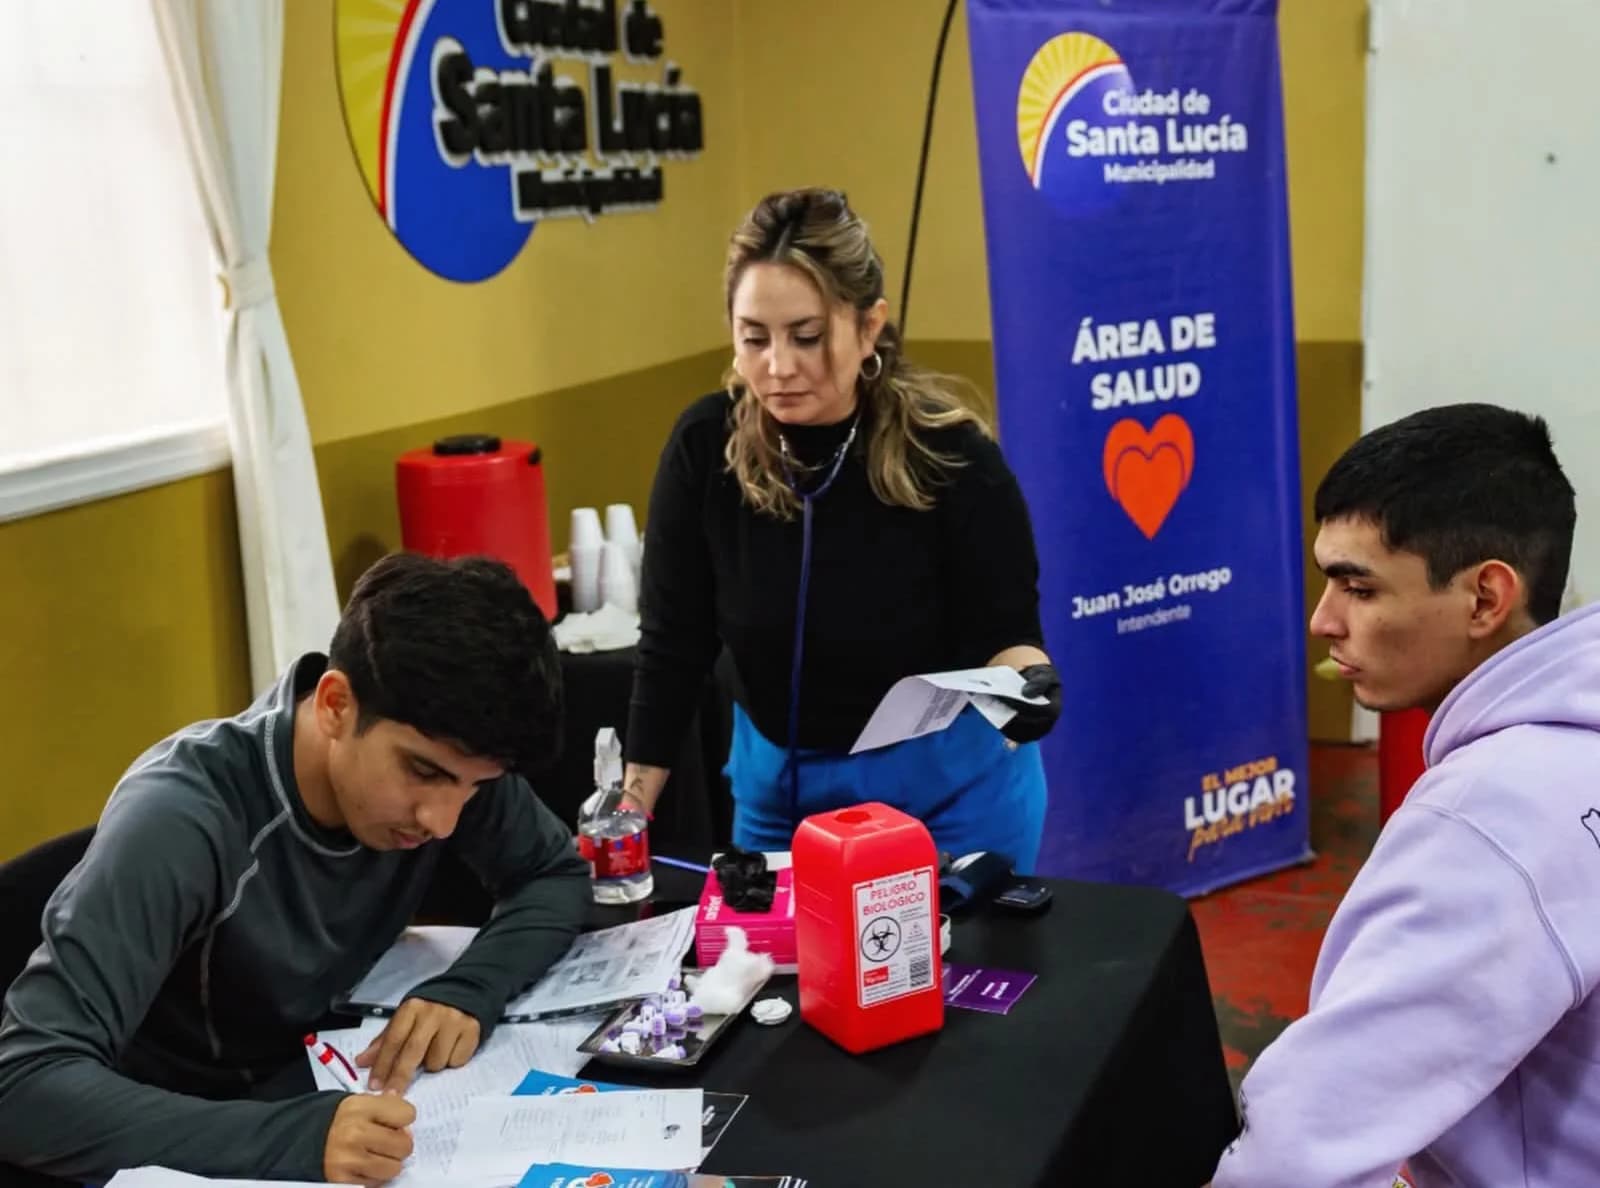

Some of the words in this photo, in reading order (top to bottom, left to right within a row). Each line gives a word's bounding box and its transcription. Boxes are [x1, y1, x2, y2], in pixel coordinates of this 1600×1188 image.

[431, 37, 587, 167] Santa
[592, 57, 704, 160] Lucía
[1102, 89, 1179, 116] Ciudad
[1182, 89, 1211, 115] de
[1065, 119, 1160, 157] Santa
[1166, 114, 1248, 154] Lucía
[1103, 158, 1216, 184] Municipalidad
[1071, 317, 1165, 365] ÁREA
[1170, 312, 1217, 351] DE
[1090, 361, 1201, 410] SALUD
[1071, 596, 1120, 620] Juan
[1122, 576, 1165, 607] José
[1168, 566, 1232, 597] Orrego
[1116, 604, 1191, 635] Intendente
[1184, 767, 1296, 831] LUGAR
[869, 880, 918, 901] PELIGRO
